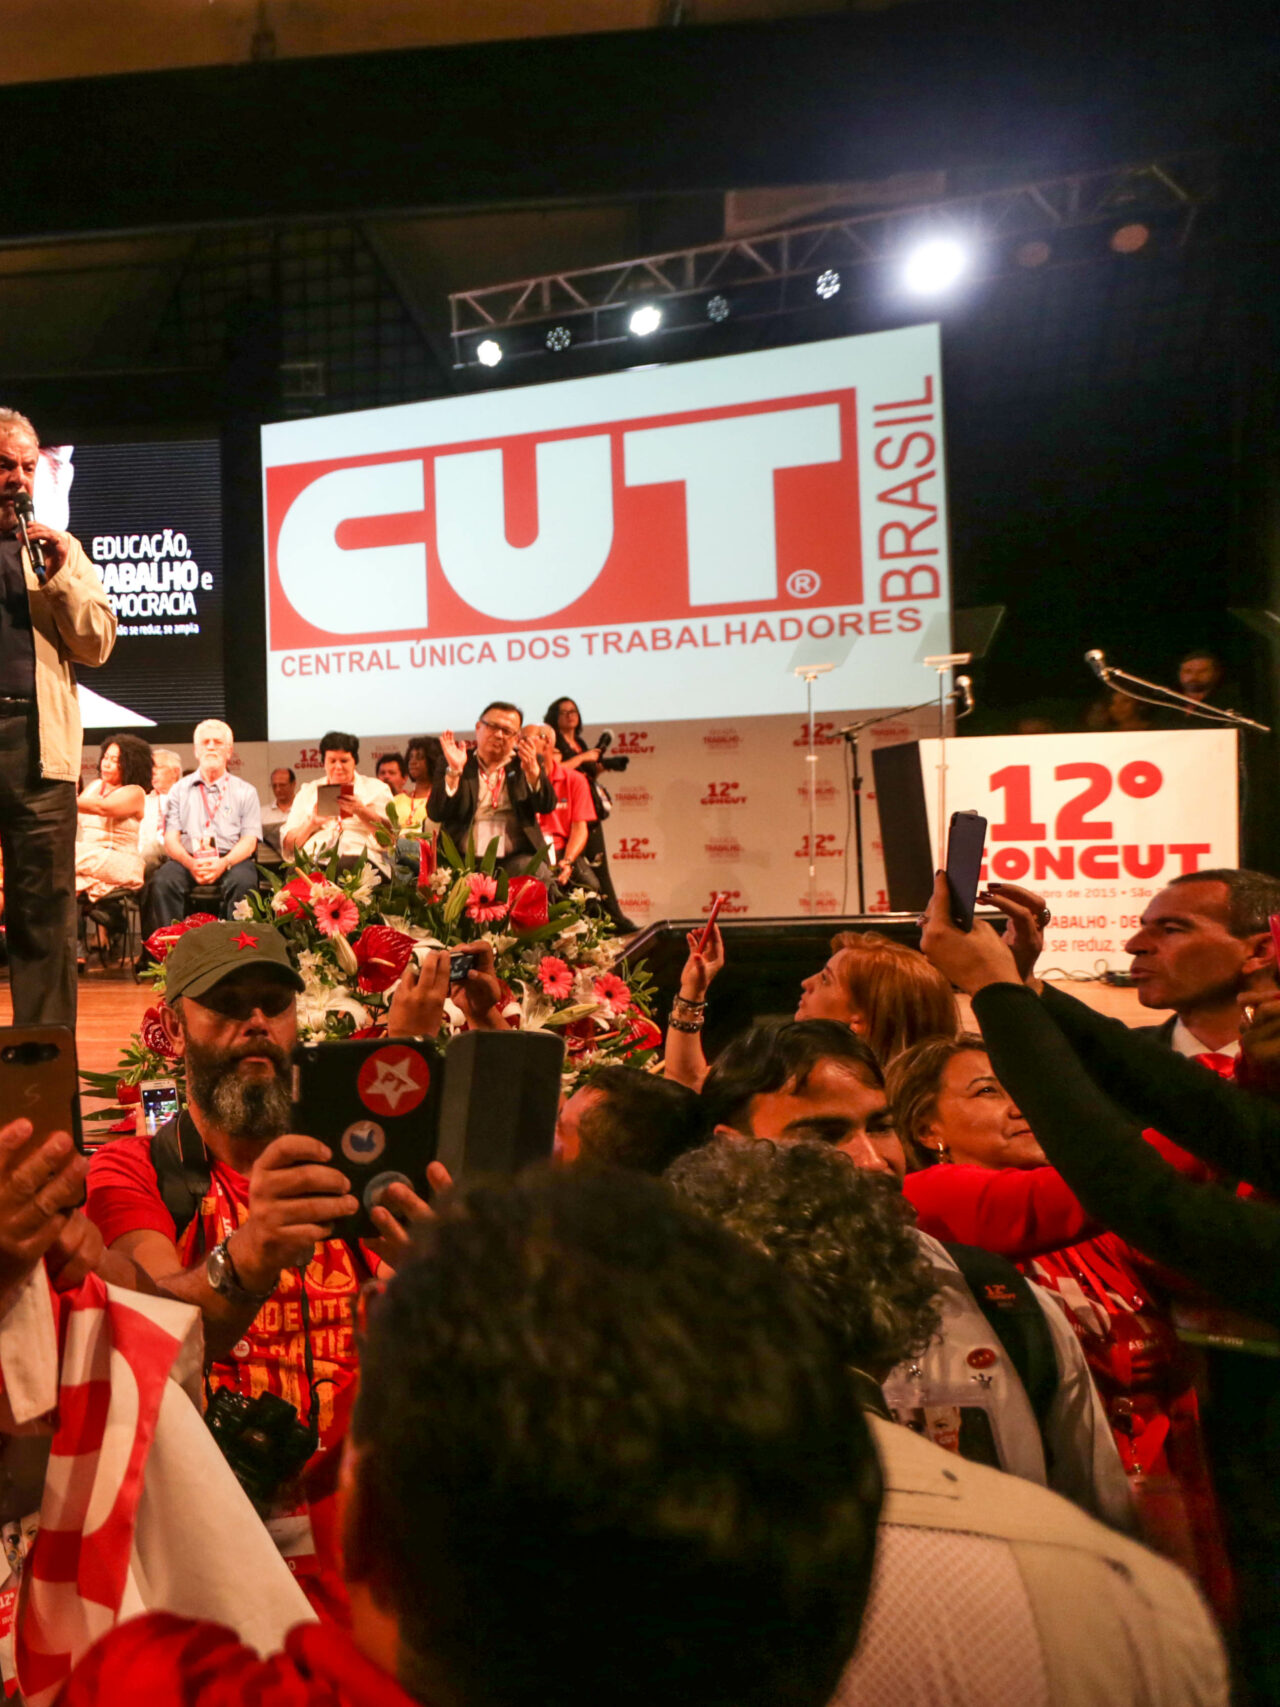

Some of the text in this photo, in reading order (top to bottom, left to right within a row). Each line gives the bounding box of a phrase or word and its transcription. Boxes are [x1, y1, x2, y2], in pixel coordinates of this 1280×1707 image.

[873, 375, 941, 603] BRASIL
[277, 403, 842, 634] CUT
[92, 529, 192, 562] EDUCAÇÃO,
[201, 571, 213, 590] e
[107, 592, 197, 617] EMOCRACIA
[281, 608, 922, 677] CENTRAL ÚNICA DOS TRABALHADORES
[294, 761, 325, 769] CONCU
[980, 843, 1211, 881] ONCUT
[1066, 887, 1080, 898] de
[1085, 887, 1117, 898] 2015
[1130, 887, 1153, 898] São
[1047, 915, 1107, 929] ABALHO
[1051, 940, 1068, 952] se
[1072, 937, 1116, 953] reduz,
[381, 1071, 408, 1092] PT
